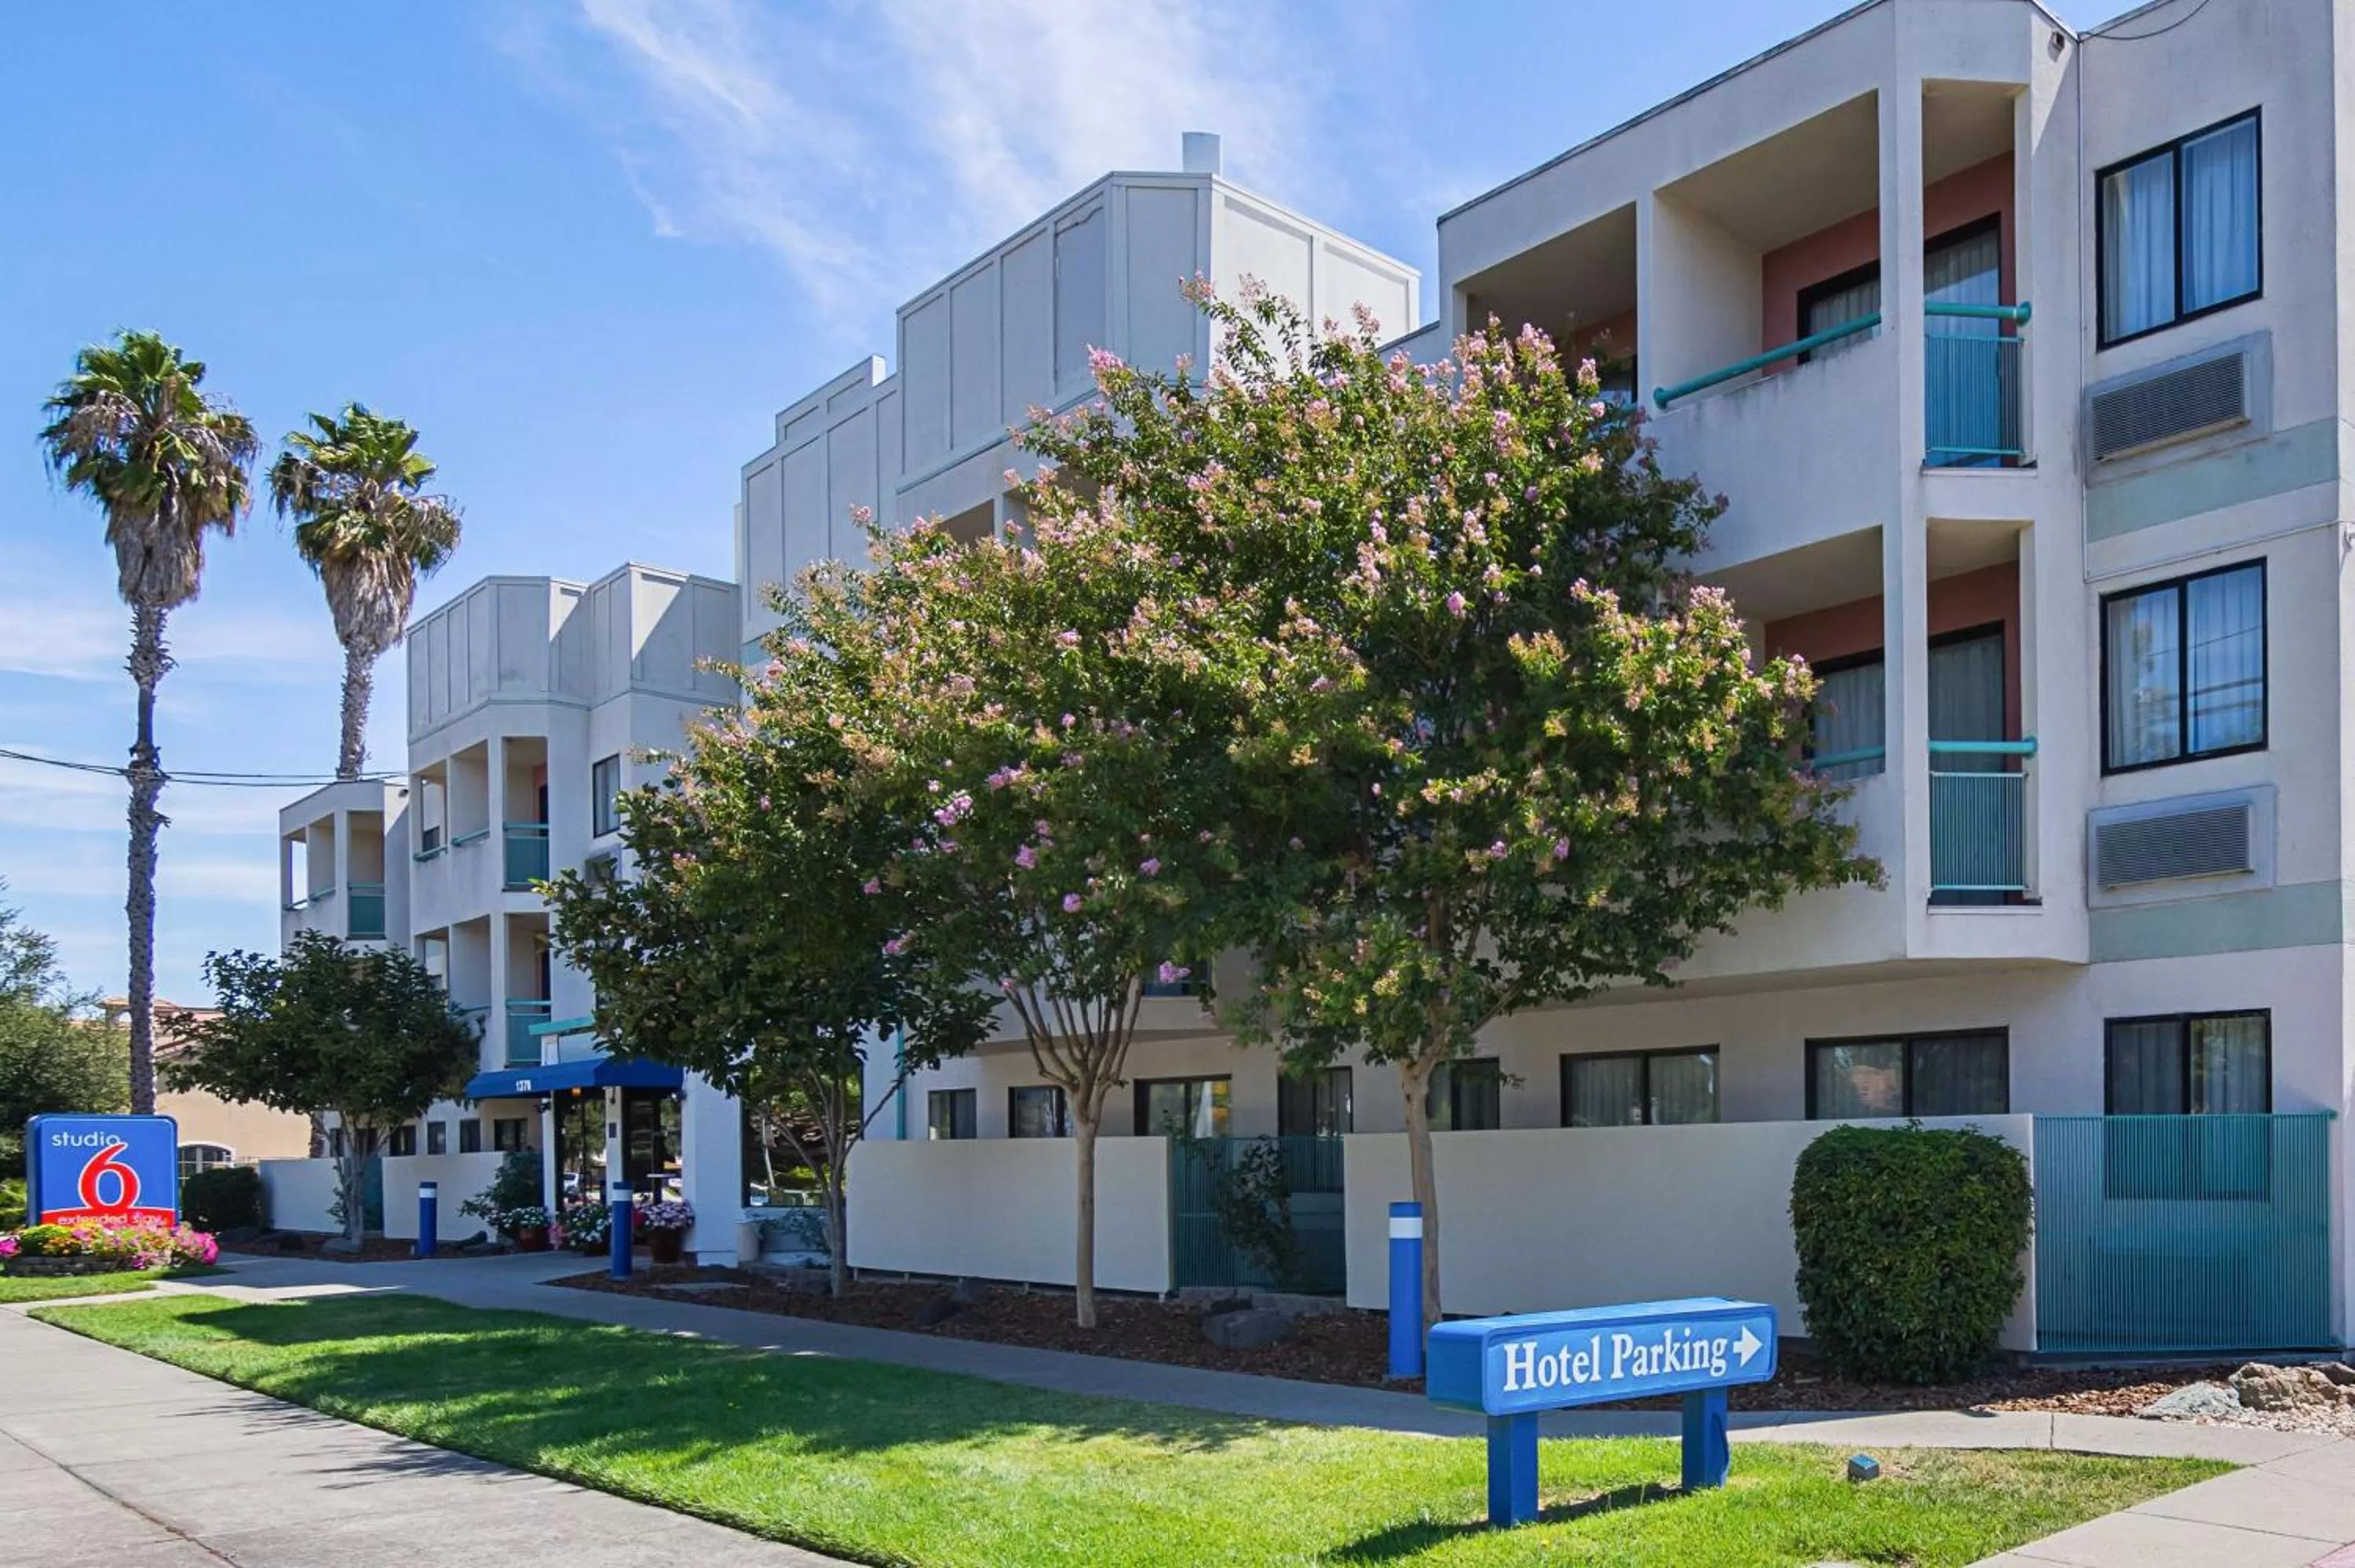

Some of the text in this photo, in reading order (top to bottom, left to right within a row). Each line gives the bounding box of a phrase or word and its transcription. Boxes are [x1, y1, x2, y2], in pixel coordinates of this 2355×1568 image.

[51, 1131, 121, 1147] studio
[78, 1142, 141, 1209] 6
[1502, 1327, 1729, 1392] Hotel Parking
